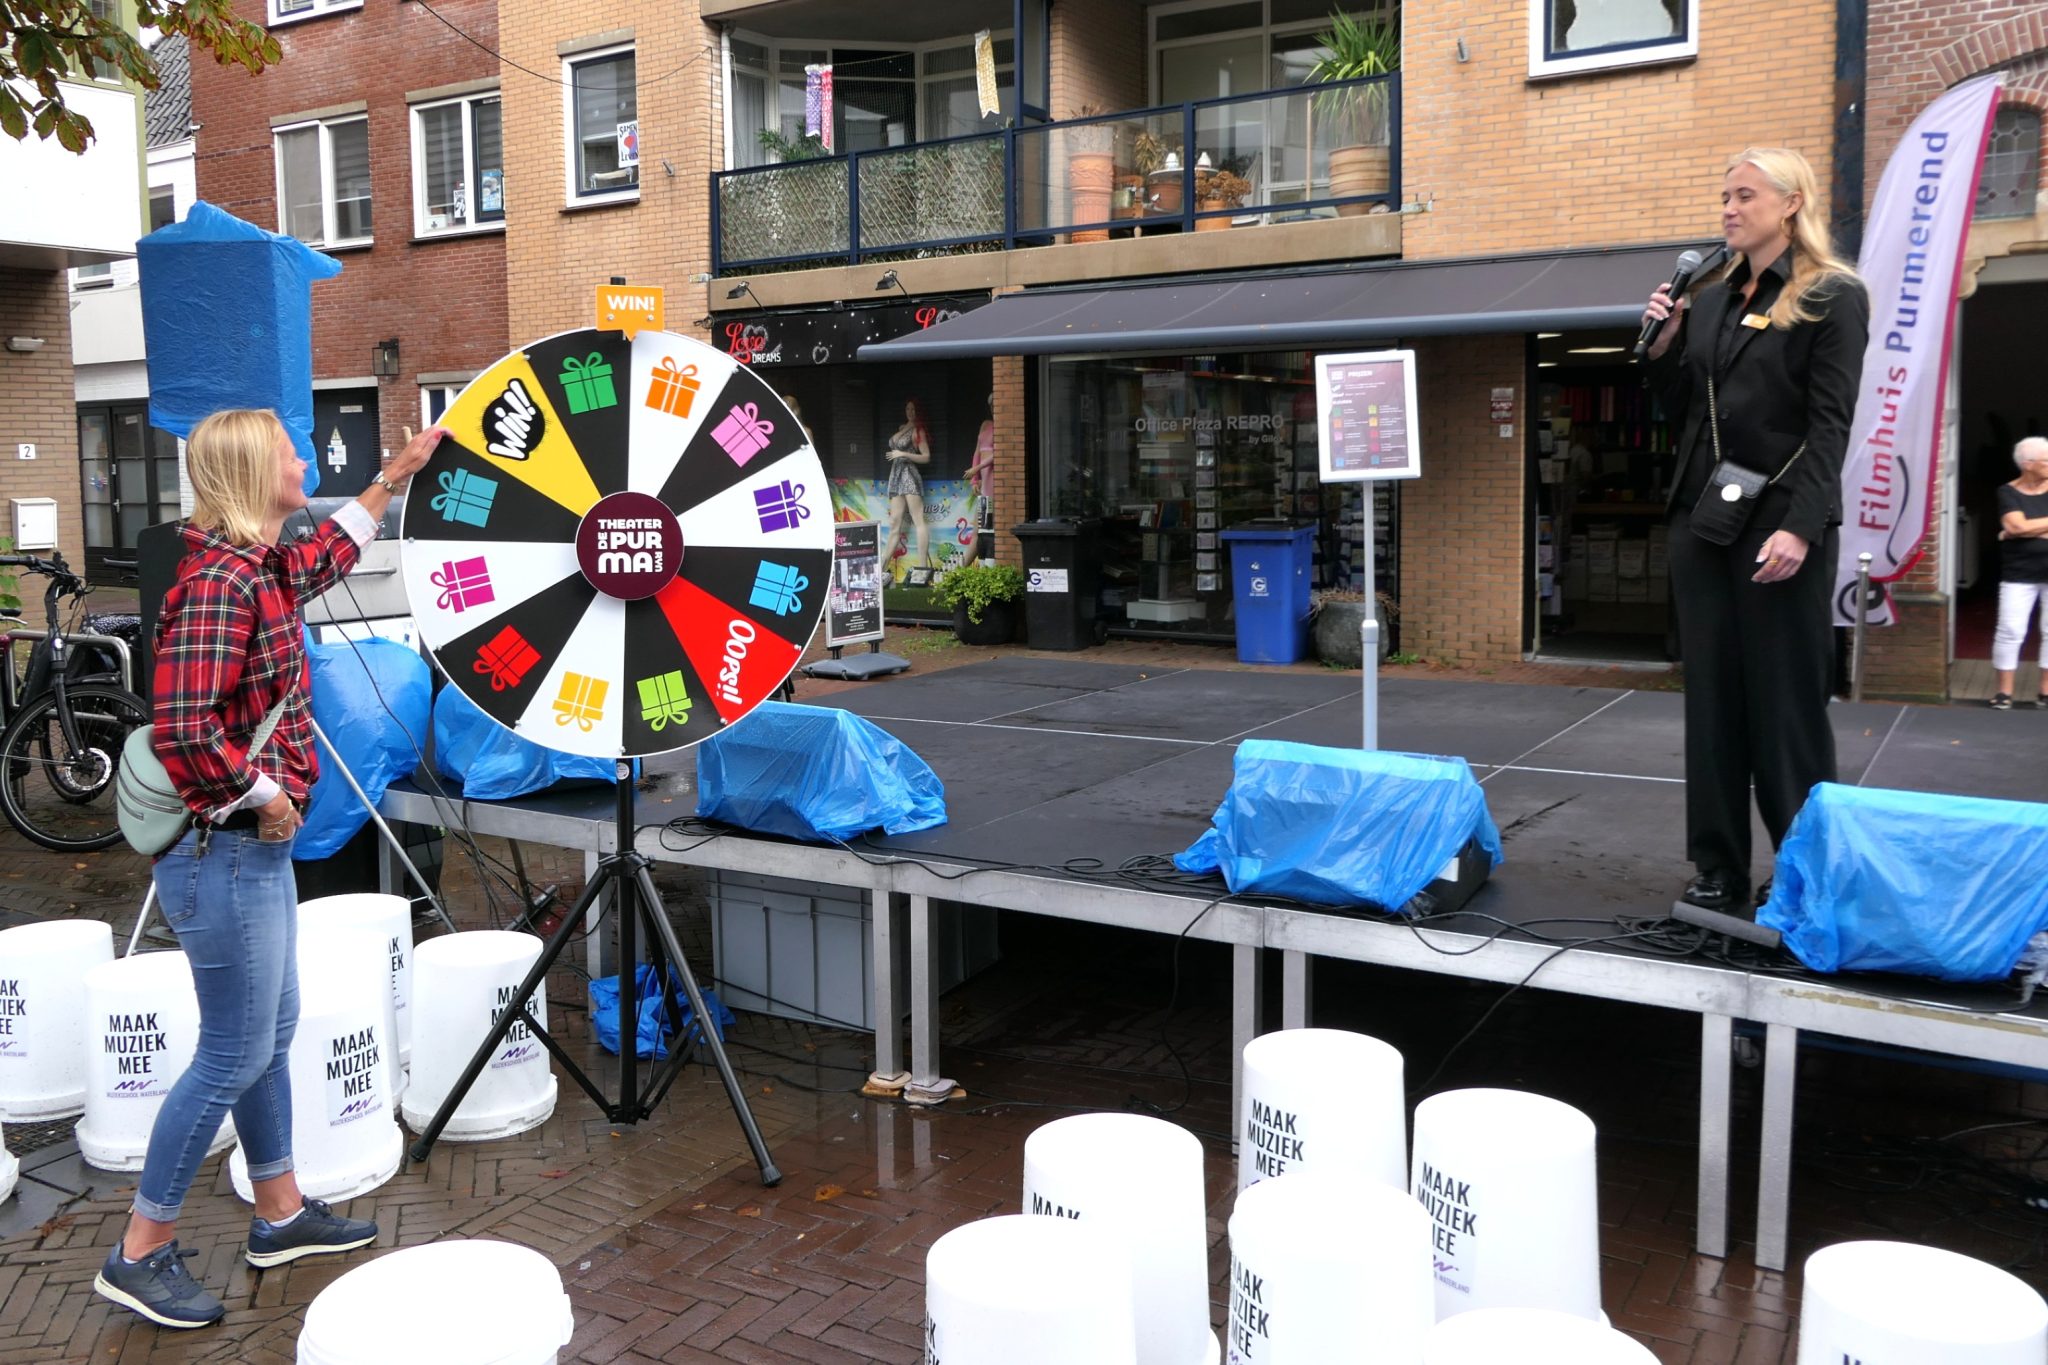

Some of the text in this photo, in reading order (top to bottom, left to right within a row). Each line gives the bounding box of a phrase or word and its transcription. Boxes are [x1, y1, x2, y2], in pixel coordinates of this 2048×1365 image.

[607, 295, 655, 311] WIN!
[1858, 131, 1949, 532] Filmhuis Purmerend
[726, 322, 766, 365] Love
[752, 352, 782, 363] DREAMS
[1135, 414, 1284, 432] Office Plaza REPRO
[1249, 435, 1258, 445] by
[24, 446, 31, 458] 2
[598, 518, 663, 530] THEATER
[597, 531, 663, 550] DE PUR
[1030, 571, 1042, 586] G
[1252, 579, 1267, 592] G
[0, 979, 19, 996] AK
[109, 1013, 158, 1033] MAAK
[104, 1032, 167, 1054] MUZIEK
[332, 1025, 375, 1058] MAAK
[118, 1055, 152, 1075] MEE
[326, 1044, 380, 1081] MUZIEK
[343, 1071, 373, 1098] MEE
[1252, 1098, 1297, 1136] MAAK
[1247, 1119, 1304, 1162] MUZIEK
[1422, 1161, 1471, 1207] MAAK
[1432, 1222, 1456, 1257] EE
